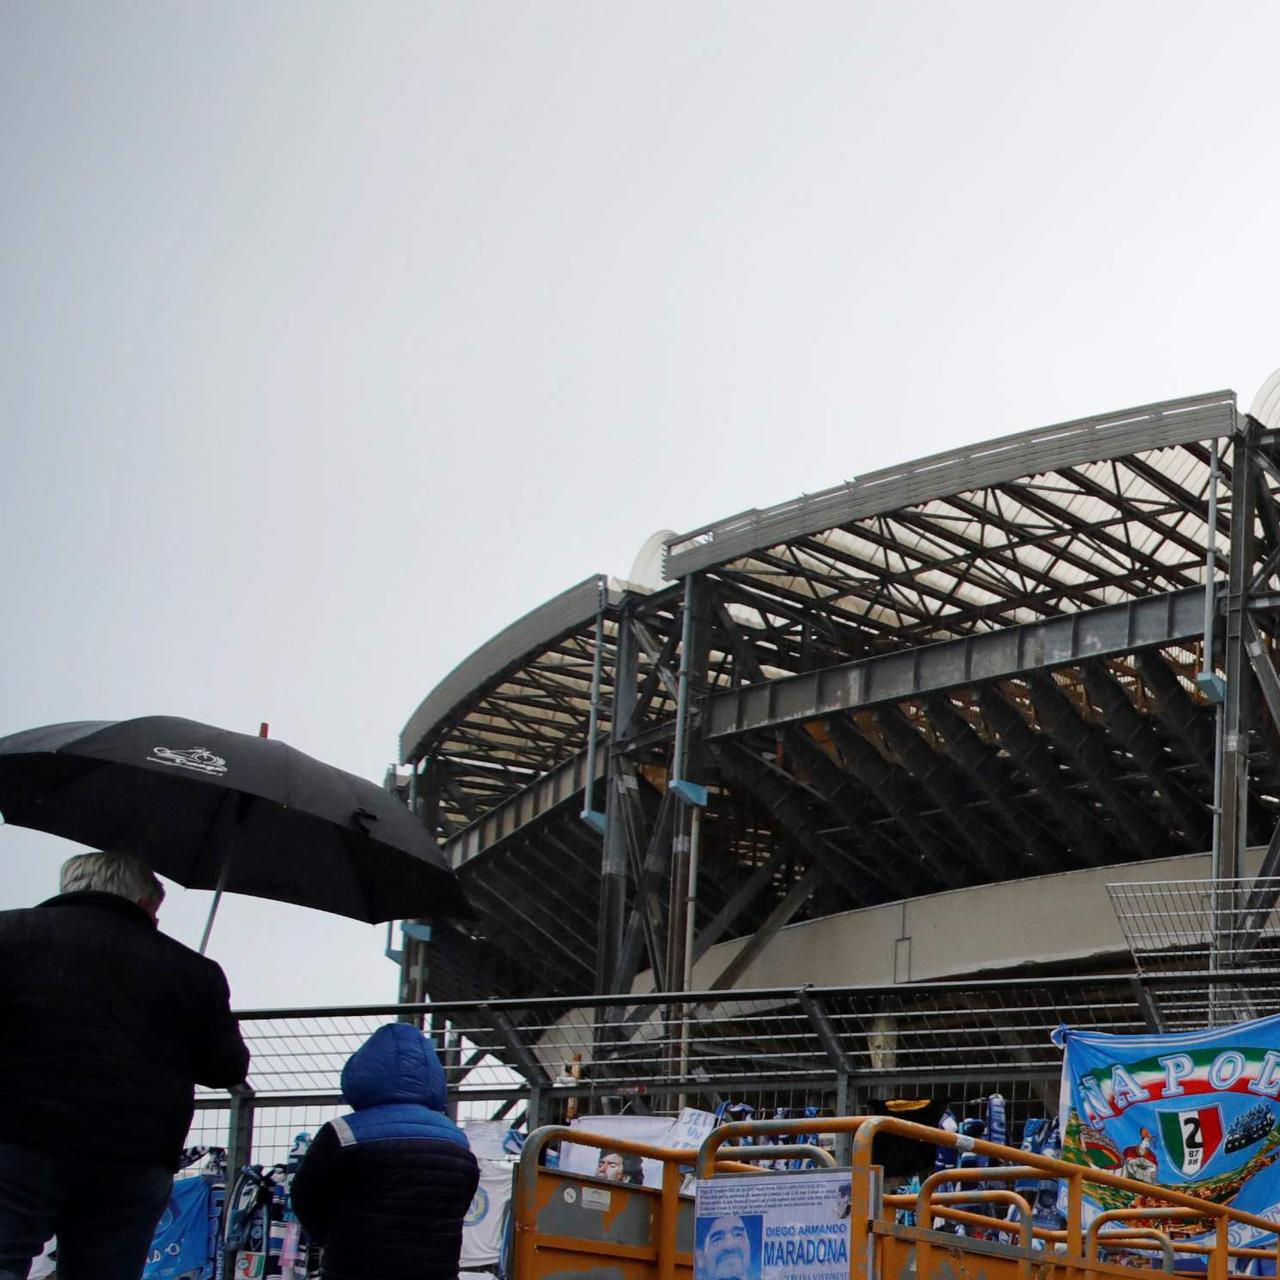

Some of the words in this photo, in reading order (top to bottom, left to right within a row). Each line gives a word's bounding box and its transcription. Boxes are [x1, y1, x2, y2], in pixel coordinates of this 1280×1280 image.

[1183, 1116, 1204, 1150] 2
[766, 1226, 796, 1237] DIEGO
[799, 1223, 847, 1235] ARMANDO
[763, 1238, 848, 1266] MARADONA
